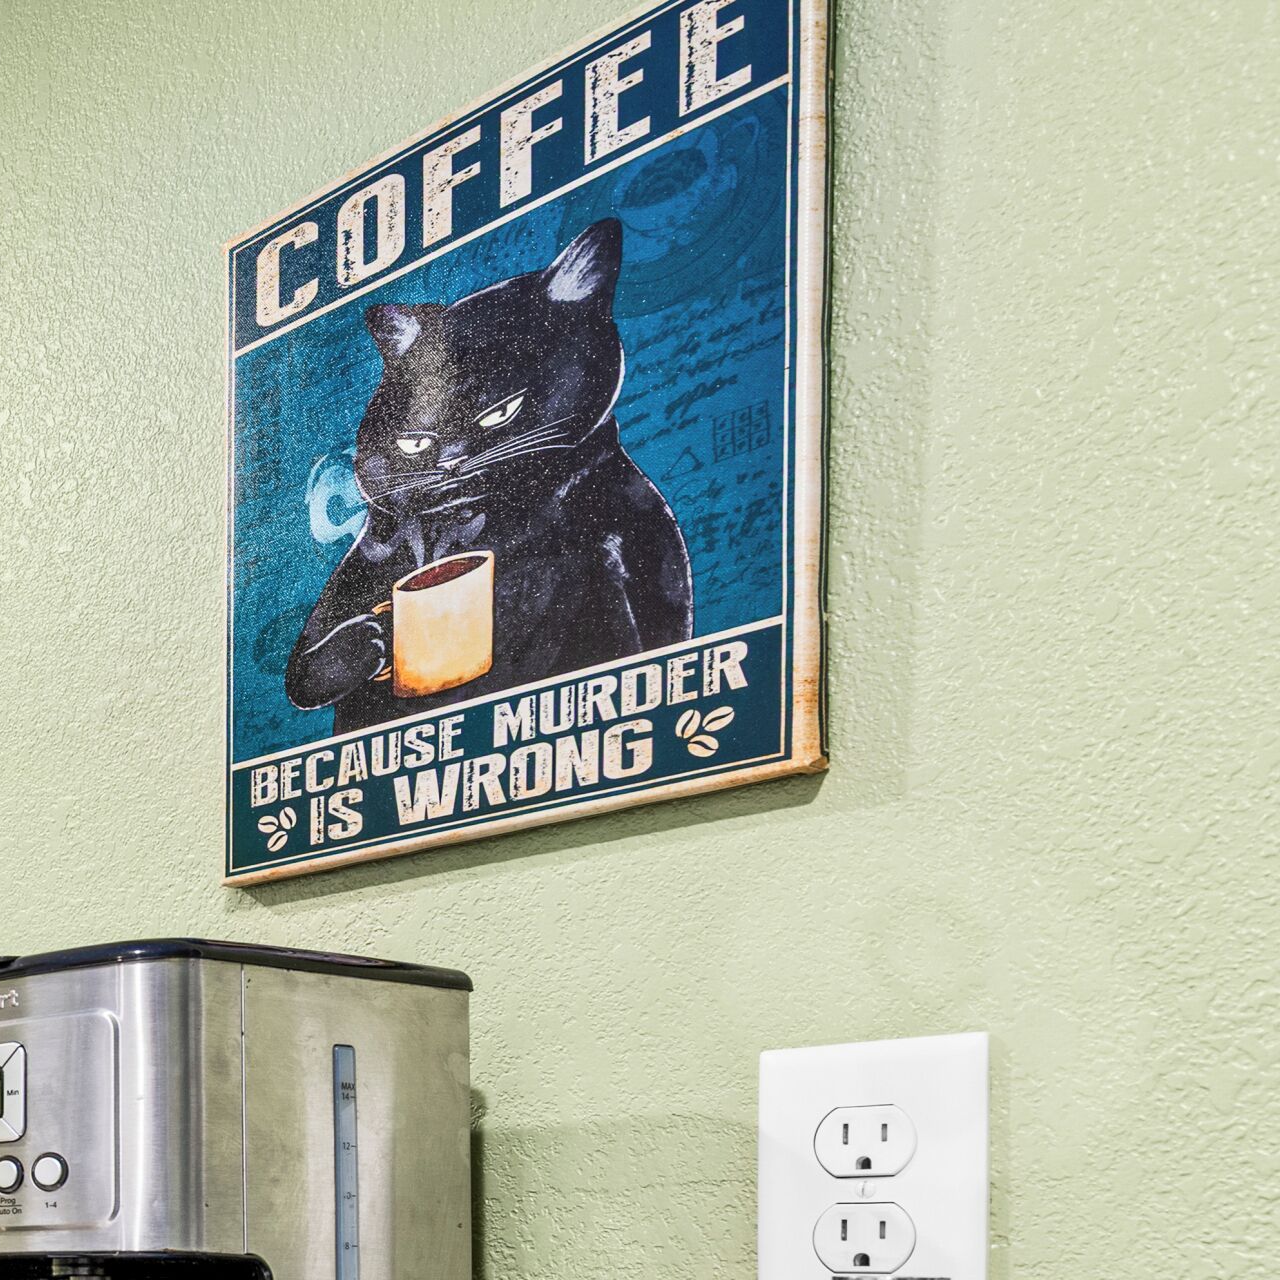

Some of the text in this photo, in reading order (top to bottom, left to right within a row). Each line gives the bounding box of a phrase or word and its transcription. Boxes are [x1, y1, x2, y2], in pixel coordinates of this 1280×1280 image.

[256, 0, 752, 327] COFFEE
[251, 640, 749, 809] BECAUSE MURDER
[309, 717, 654, 847] IS WRONG
[341, 1082, 356, 1091] MAX
[6, 1089, 20, 1097] Min
[0, 1197, 16, 1206] Prog
[11, 1207, 22, 1215] On
